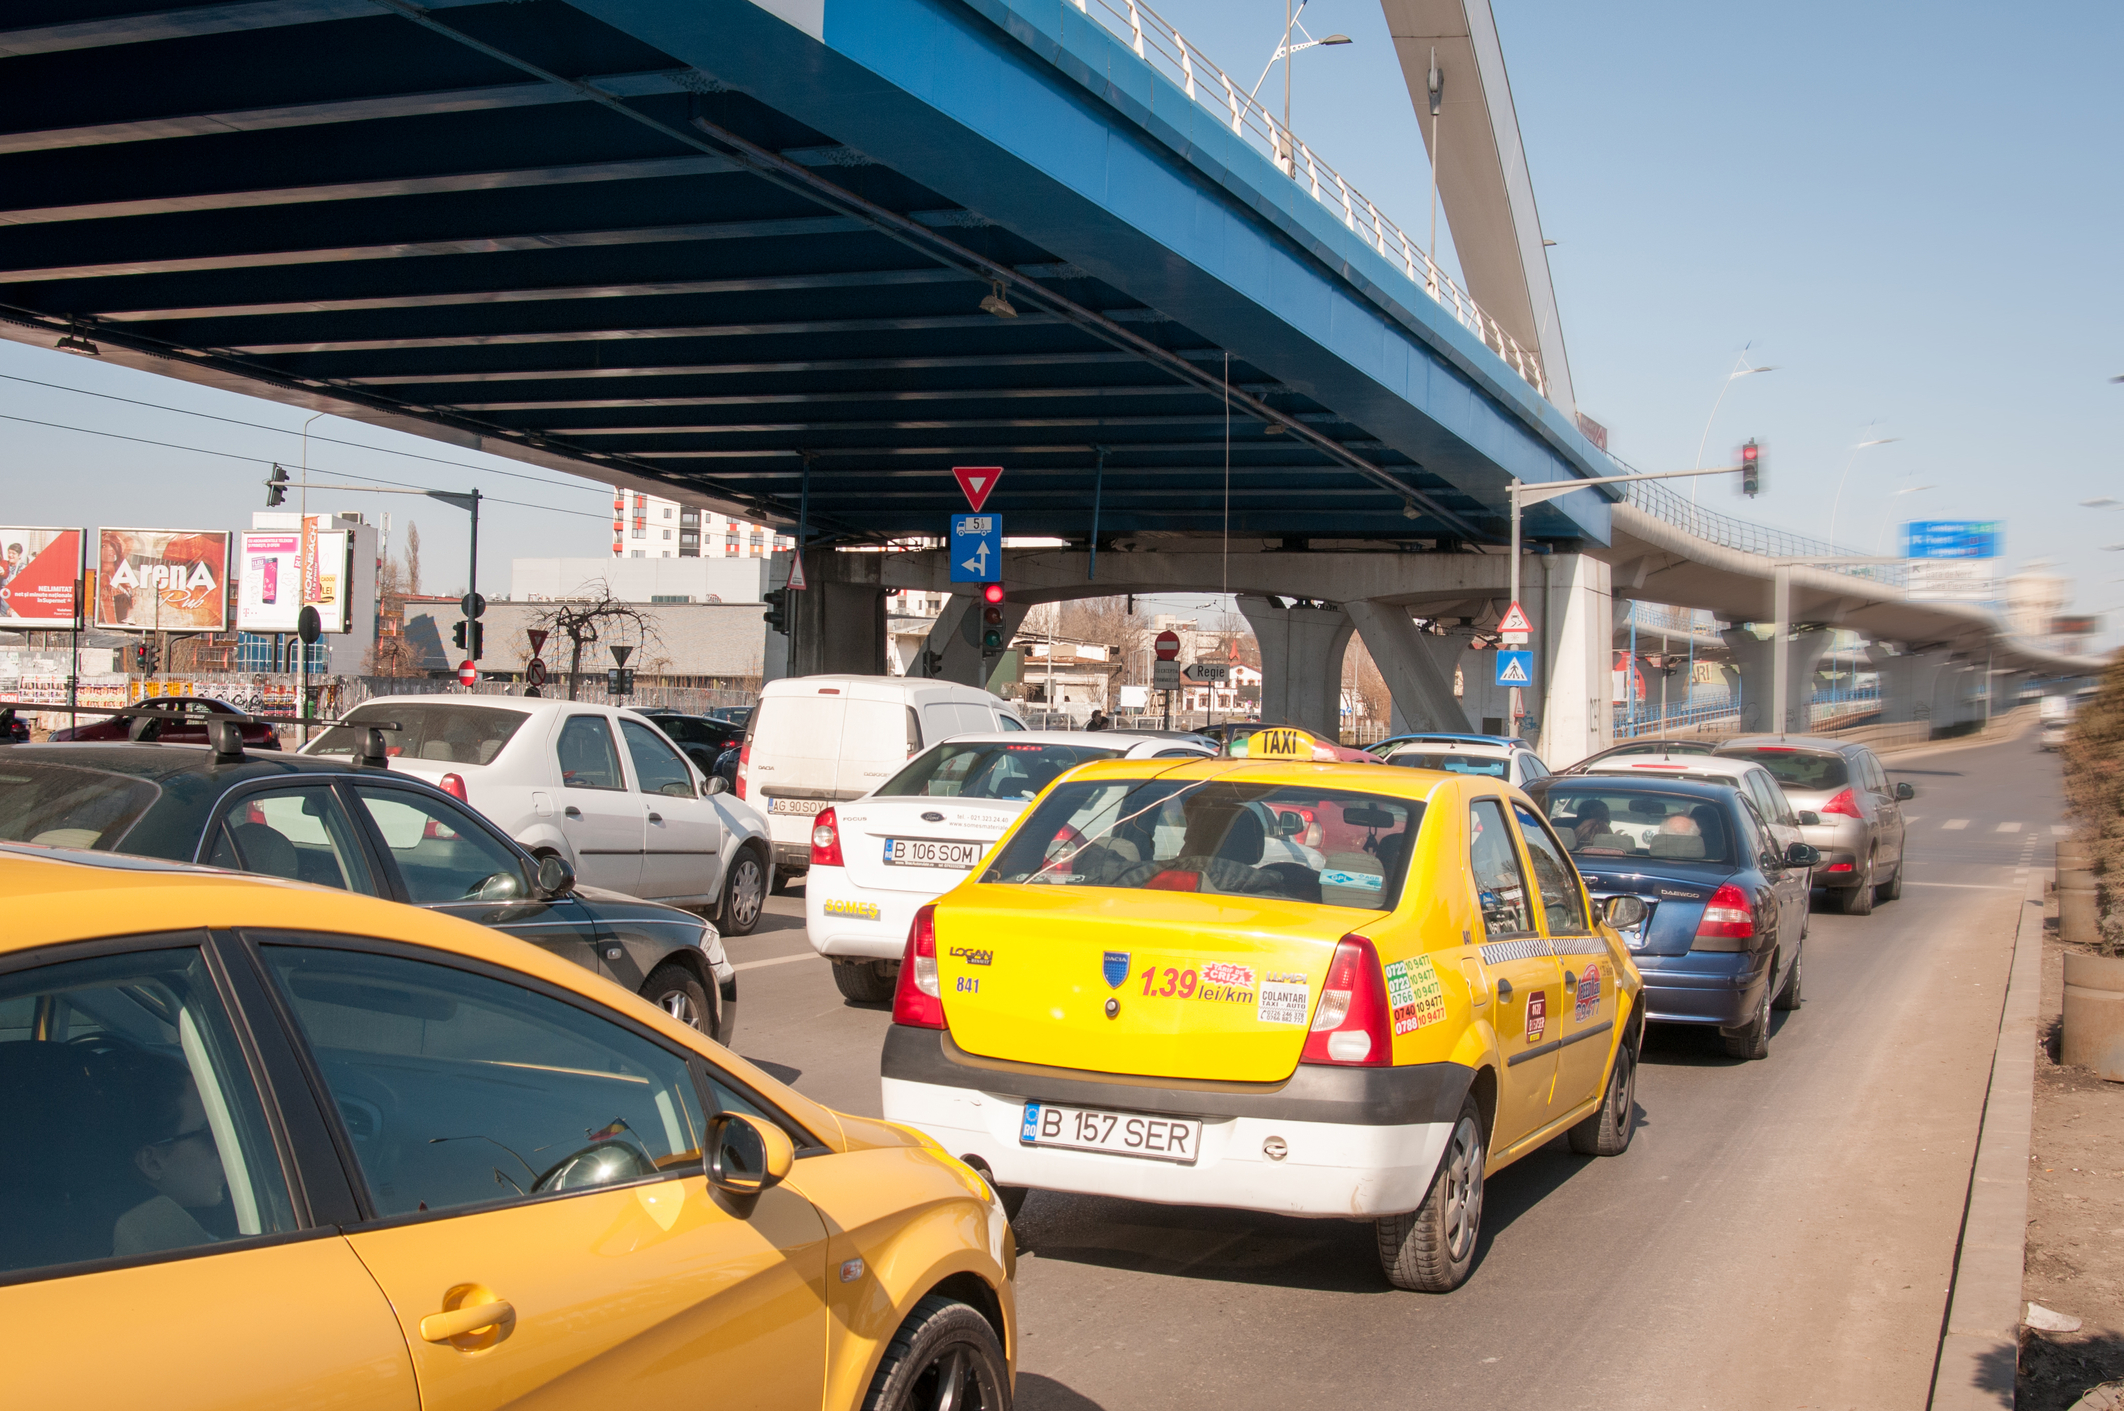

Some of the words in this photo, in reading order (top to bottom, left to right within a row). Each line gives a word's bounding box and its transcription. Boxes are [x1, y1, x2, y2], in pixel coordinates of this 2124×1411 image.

[304, 524, 318, 601] HORNBACH
[158, 589, 209, 609] Pub
[1197, 665, 1225, 680] Regie
[1261, 730, 1297, 754] TAXI
[773, 800, 786, 812] AG
[789, 801, 801, 812] 90
[802, 801, 825, 813] SOY
[894, 842, 906, 858] B
[912, 843, 936, 860] 106
[938, 845, 973, 863] SOM
[1661, 889, 1700, 899] DAEWOO
[949, 946, 994, 960] LOGAN
[1104, 955, 1127, 963] DACIA
[1214, 964, 1235, 973] TARIF
[1385, 962, 1407, 978] 0722
[1405, 960, 1414, 971] 10
[1413, 954, 1431, 966] 9477
[956, 976, 980, 994] 841
[1140, 965, 1198, 999] 1.39
[1209, 969, 1247, 985] CRIZA
[1388, 976, 1411, 993] 0723
[1409, 974, 1418, 986] 10
[1417, 968, 1436, 983] 9477
[1198, 985, 1253, 1003] lei/km
[1262, 990, 1307, 1003] COLANTARI
[1391, 990, 1414, 1006] 0766
[1413, 988, 1422, 1000] 10
[1422, 981, 1440, 997] 9477
[1286, 1002, 1306, 1010] AUTO
[1394, 1004, 1416, 1021] 0740
[1416, 1001, 1425, 1013] 10
[1424, 995, 1443, 1010] 9477
[1395, 1017, 1418, 1035] 0788
[1418, 1014, 1427, 1026] 10
[1426, 1007, 1445, 1023] 9477
[1023, 1123, 1037, 1138] RO
[1041, 1108, 1063, 1138] B
[1074, 1111, 1119, 1144] 157
[1124, 1117, 1190, 1154] SER
